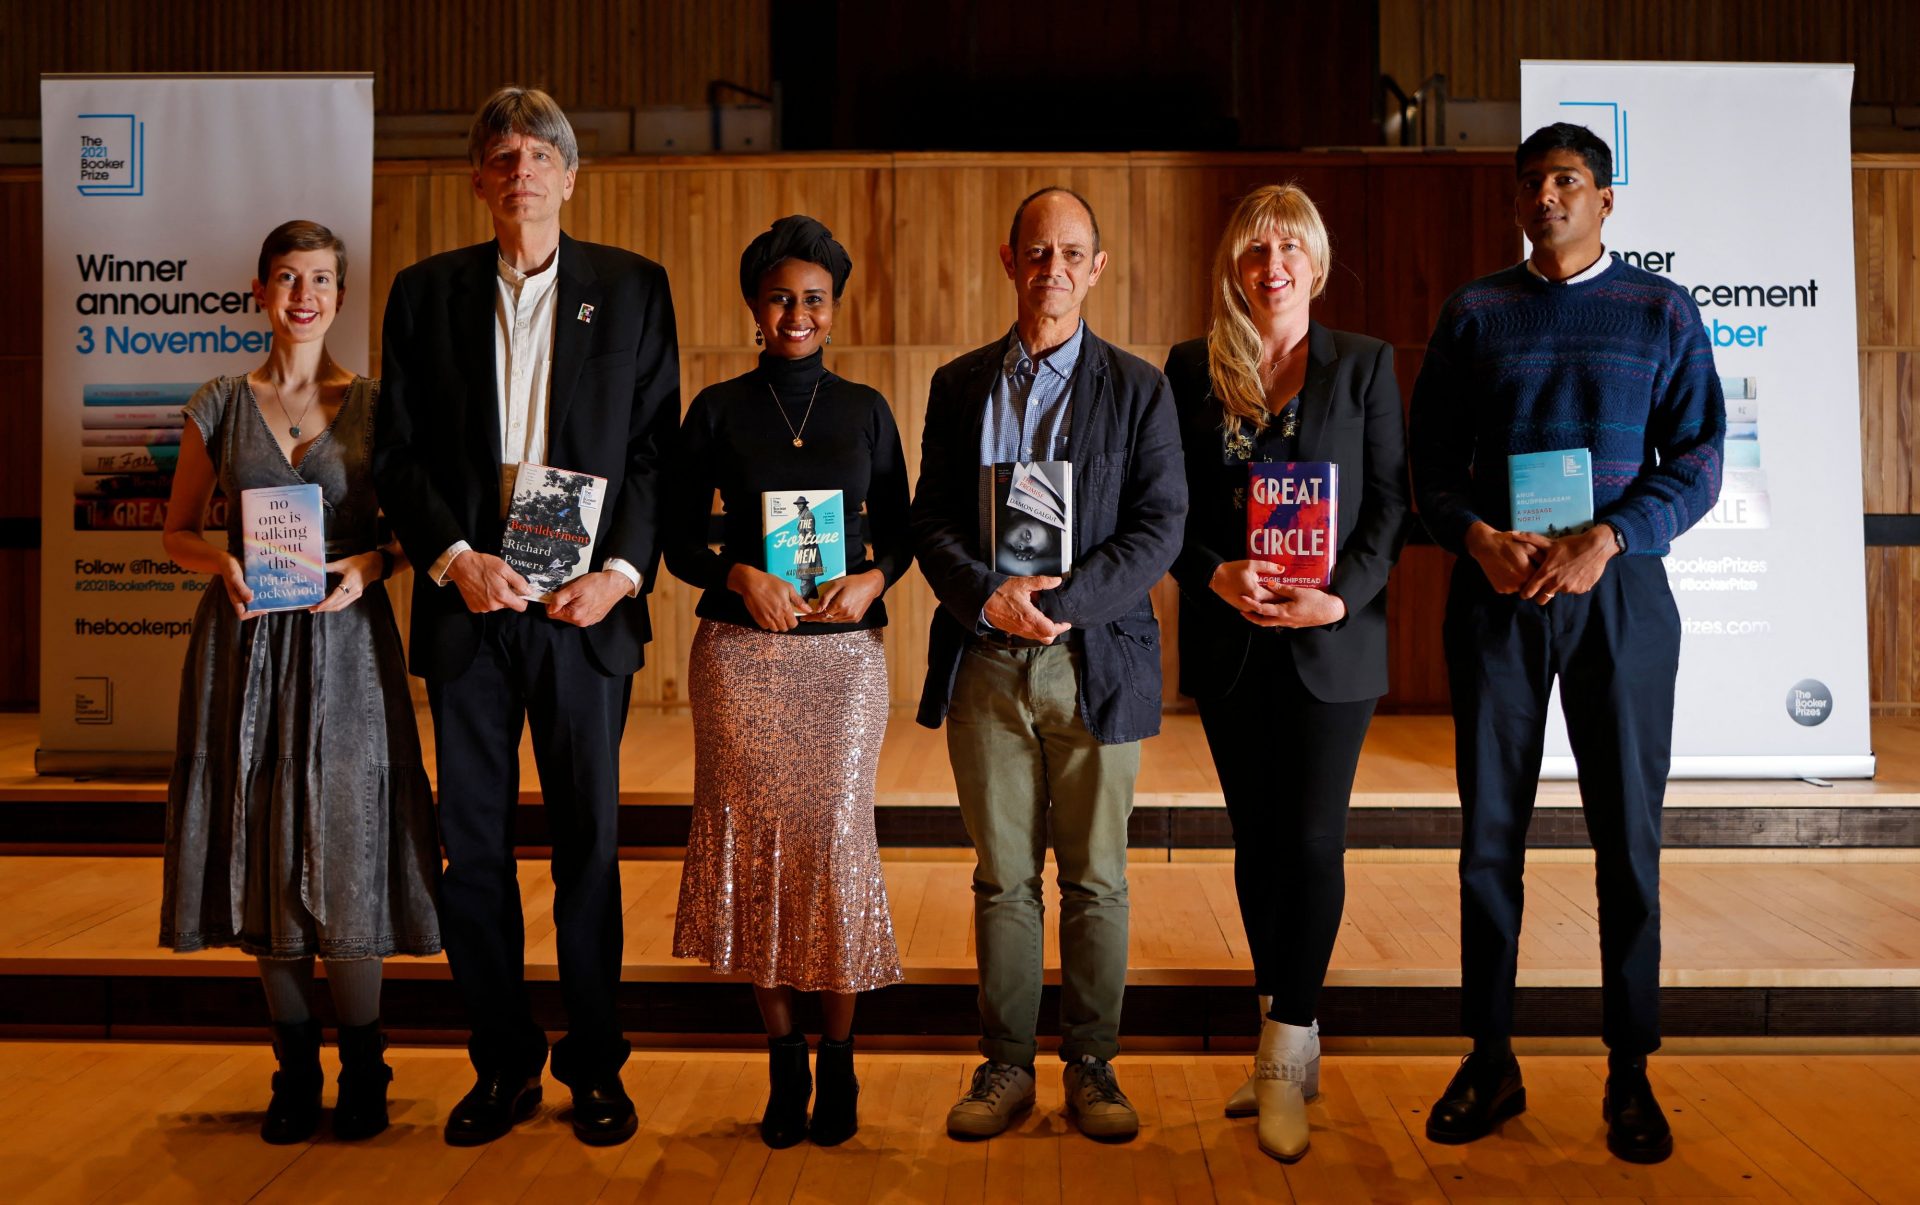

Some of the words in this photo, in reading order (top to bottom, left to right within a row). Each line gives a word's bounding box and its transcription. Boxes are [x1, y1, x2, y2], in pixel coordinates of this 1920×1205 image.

[80, 135, 103, 147] The
[80, 147, 107, 158] 2021
[80, 158, 125, 169] Booker
[80, 169, 109, 181] Prize
[76, 254, 187, 282] Winner
[1688, 278, 1818, 308] cement
[76, 325, 95, 354] 3
[106, 325, 273, 353] November
[1019, 482, 1046, 499] PROMISE
[1252, 477, 1323, 505] GREAT
[270, 499, 288, 510] no
[1009, 498, 1034, 512] DAMON
[1034, 508, 1057, 523] GALGUT
[259, 515, 286, 526] one
[290, 511, 301, 523] is
[799, 518, 813, 529] THE
[255, 526, 307, 541] talking
[511, 519, 590, 544] Bewilderment
[773, 530, 840, 549] Fortune
[1250, 528, 1325, 556] CIRCLE
[260, 543, 304, 556] about
[507, 539, 552, 557] Richard
[268, 556, 297, 570] this
[504, 554, 544, 571] Powers
[793, 547, 817, 565] MEN
[75, 559, 125, 574] Follow
[75, 579, 175, 592] #2021BookerPrize
[259, 572, 308, 587] Patricia
[1282, 576, 1321, 584] SHIPSTEAD
[1679, 577, 1759, 591] #BookerPrize
[251, 583, 318, 600] Lockwood
[1795, 689, 1811, 699] The
[1795, 698, 1827, 708] Booker
[1795, 707, 1821, 717] Prizes
